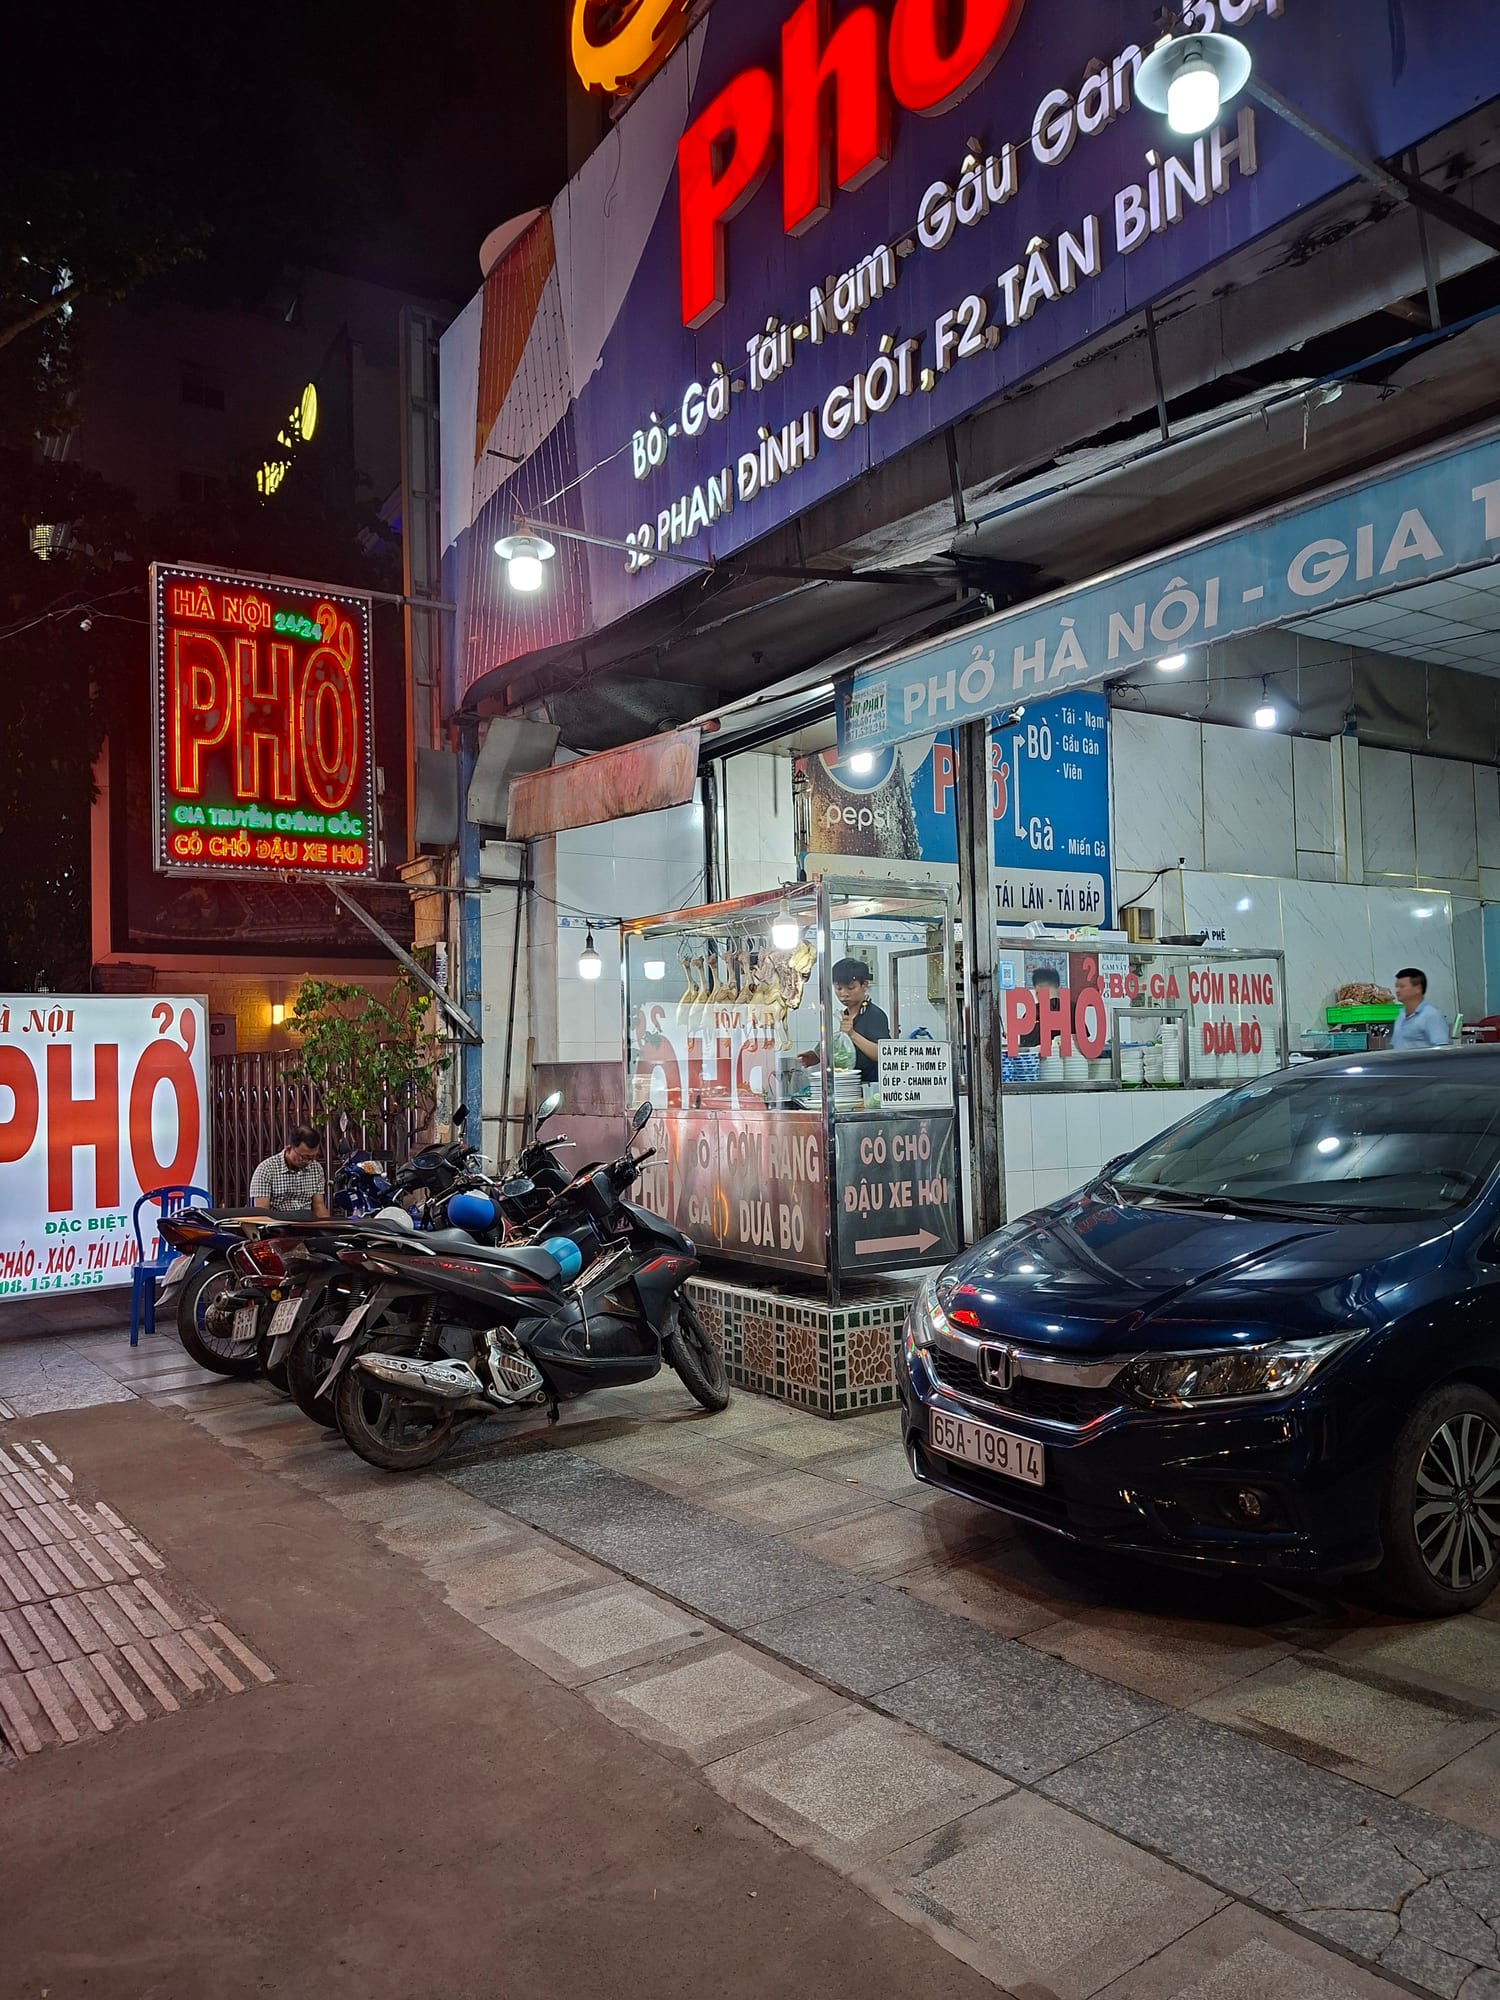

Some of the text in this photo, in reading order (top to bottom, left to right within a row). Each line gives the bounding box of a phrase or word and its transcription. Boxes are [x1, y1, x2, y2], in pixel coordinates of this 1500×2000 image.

[681, 361, 740, 436] Gà
[746, 316, 792, 391] Tái
[809, 244, 896, 344] Nạm
[917, 136, 1017, 250] Gầu
[657, 467, 733, 552] PHAN
[738, 426, 816, 501] ĐÌNH
[997, 235, 1101, 327] TÂN
[1114, 105, 1258, 255] BÌNH
[174, 586, 271, 632] HÀ NỘI
[903, 643, 995, 727] PHỞ
[1012, 617, 1088, 690] HÀ
[1287, 508, 1445, 597] GIA
[174, 604, 357, 809] PHỞ
[1027, 717, 1052, 761] BÒ
[1061, 707, 1076, 725] Tái
[1085, 711, 1105, 731] Nạm
[1062, 733, 1099, 755] Gầu Gân
[1063, 762, 1083, 780] Viên
[256, 837, 298, 864] ĐẬU
[302, 841, 328, 863] XE
[1029, 816, 1106, 857] Gà Miến Gà
[995, 880, 1014, 908] TÁI
[1021, 882, 1044, 910] LĂN
[1056, 883, 1076, 911] TÁI
[1078, 881, 1100, 912] BẮP
[1211, 928, 1226, 941] PHÊ
[23, 1004, 75, 1037] NỘI
[1005, 957, 1107, 1059] PHỞ
[1109, 965, 1140, 1000] BÒ
[1188, 965, 1224, 1005] CƠM
[1228, 973, 1274, 1006] RANG
[893, 1044, 908, 1056] PHÊ
[909, 1046, 924, 1056] PHA
[1240, 1015, 1262, 1055] BÒ
[882, 1061, 899, 1071] CAM
[916, 1060, 936, 1071] THƠM
[907, 1076, 932, 1086] CHANH
[768, 1135, 820, 1183] RANG
[860, 1121, 931, 1165] CÓ CHỖ
[844, 1173, 948, 1218] ĐẬU XE HƠI
[44, 1214, 128, 1237] ĐẶC BIỆT
[738, 1192, 806, 1254] DƯA BÒ
[44, 1239, 75, 1274] XÀO
[87, 1235, 110, 1271] TÁI
[934, 1415, 1039, 1479] 65A-199.14
